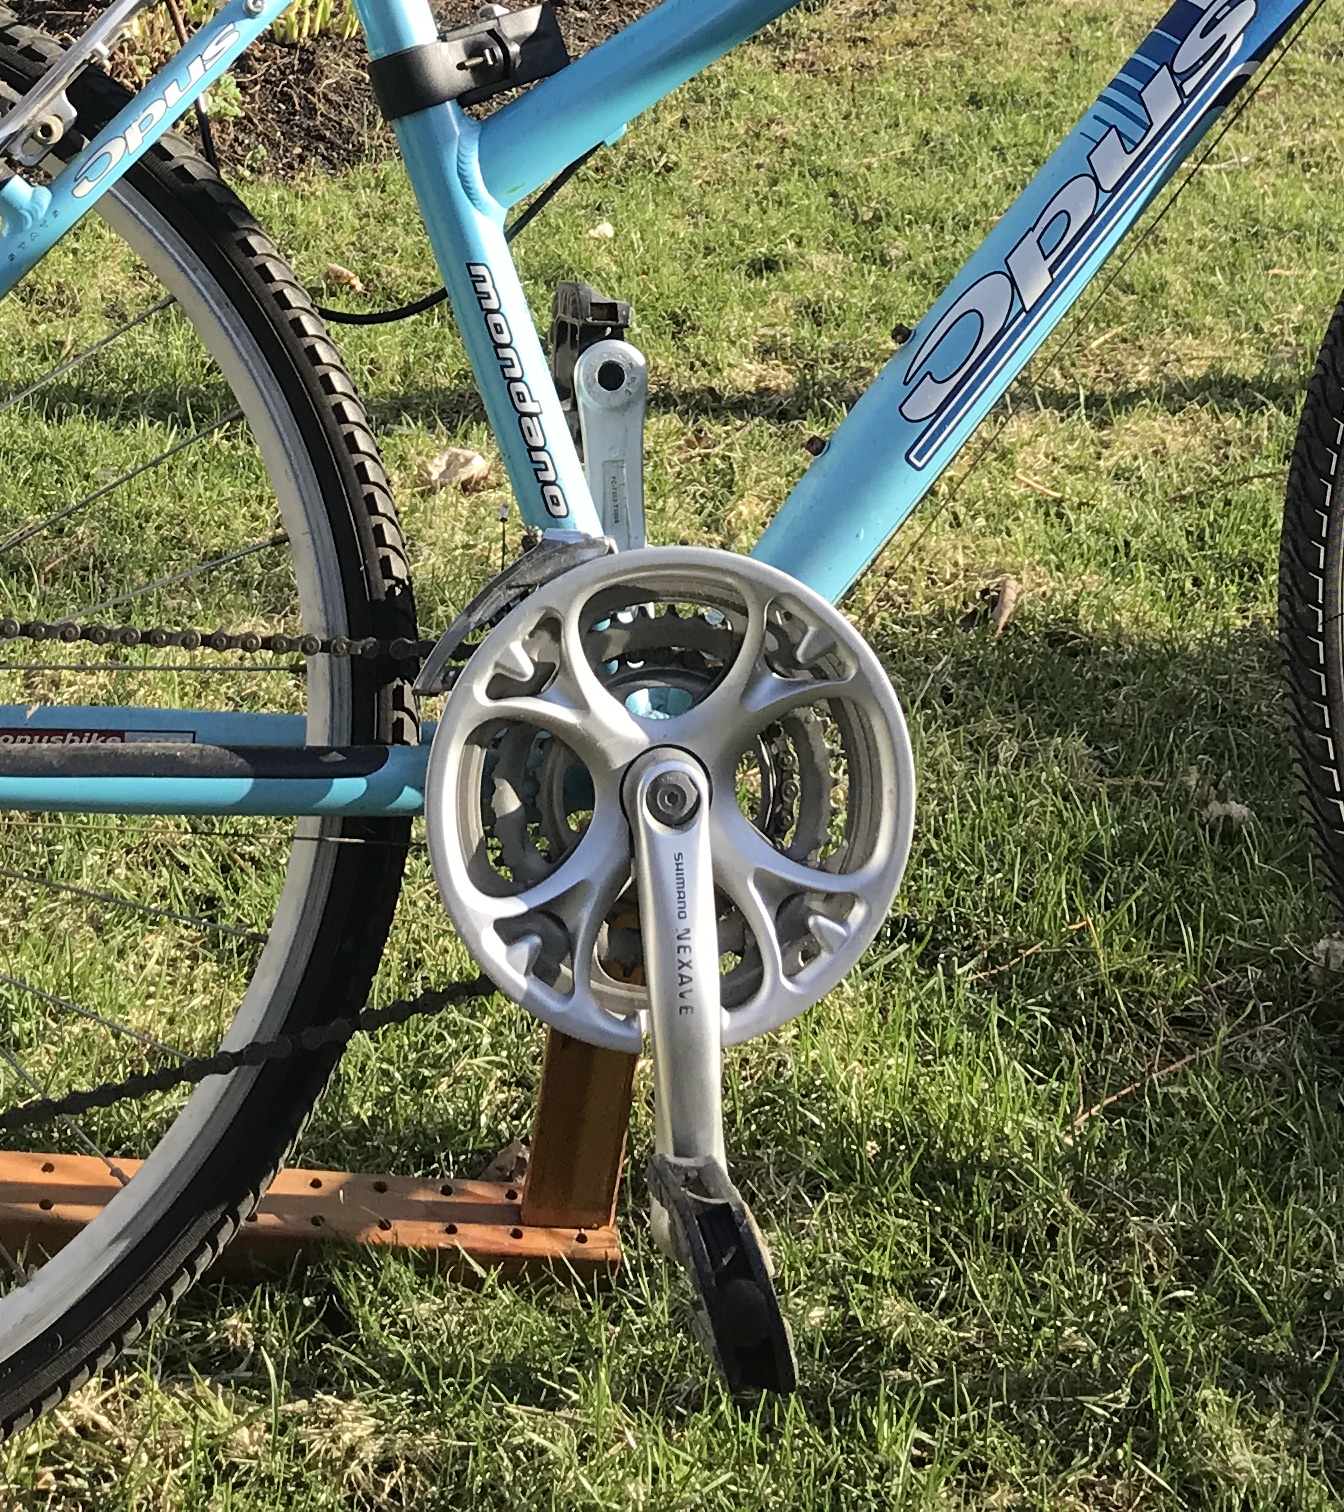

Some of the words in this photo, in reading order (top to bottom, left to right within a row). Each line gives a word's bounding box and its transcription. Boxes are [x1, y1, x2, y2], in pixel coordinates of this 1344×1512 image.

[466, 262, 570, 519] mondano
[674, 851, 687, 920] SHIMANO
[676, 927, 695, 1016] NEXAVE
